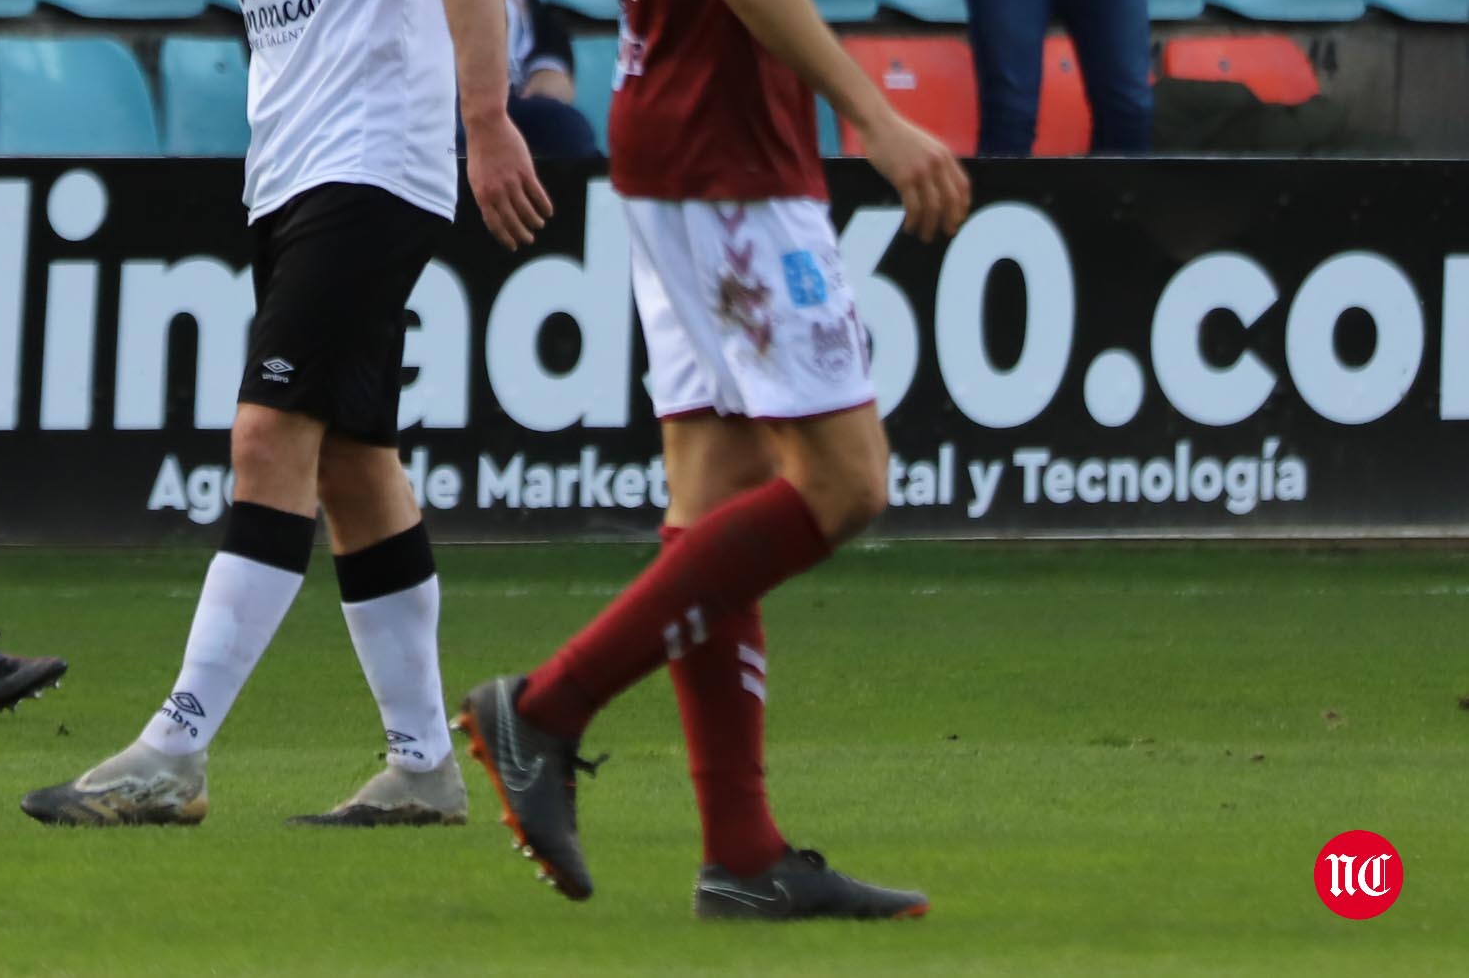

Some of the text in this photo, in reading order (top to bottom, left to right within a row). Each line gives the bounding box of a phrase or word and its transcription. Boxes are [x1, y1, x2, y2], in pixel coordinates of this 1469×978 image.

[477, 445, 671, 509] Market
[967, 460, 1003, 518] y
[1013, 437, 1308, 515] Tecnología
